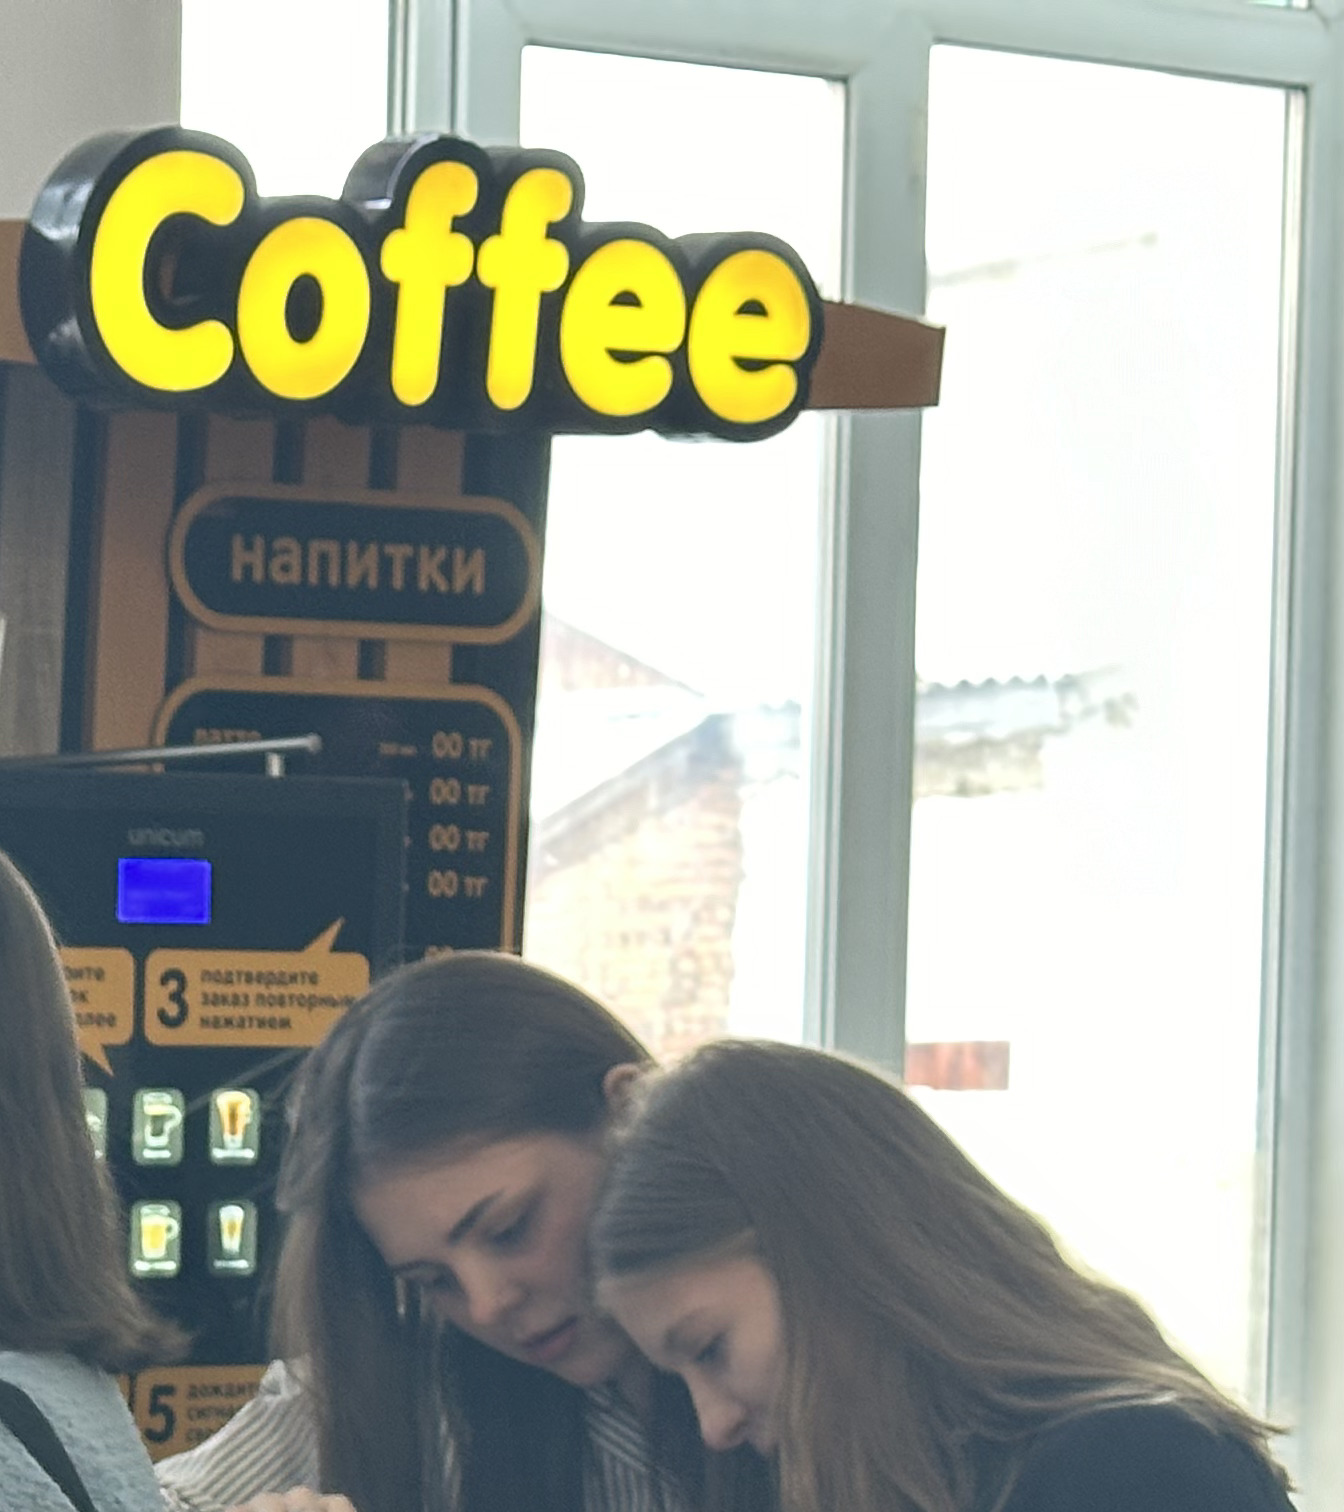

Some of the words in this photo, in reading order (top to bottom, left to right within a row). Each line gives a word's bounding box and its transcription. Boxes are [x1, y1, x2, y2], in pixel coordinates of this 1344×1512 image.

[90, 150, 811, 424] Coffee
[230, 533, 487, 595] напитки
[157, 967, 189, 1028] 3
[200, 969, 318, 989] подтвердите
[201, 991, 249, 1007] заказ
[144, 1384, 178, 1443] 5
